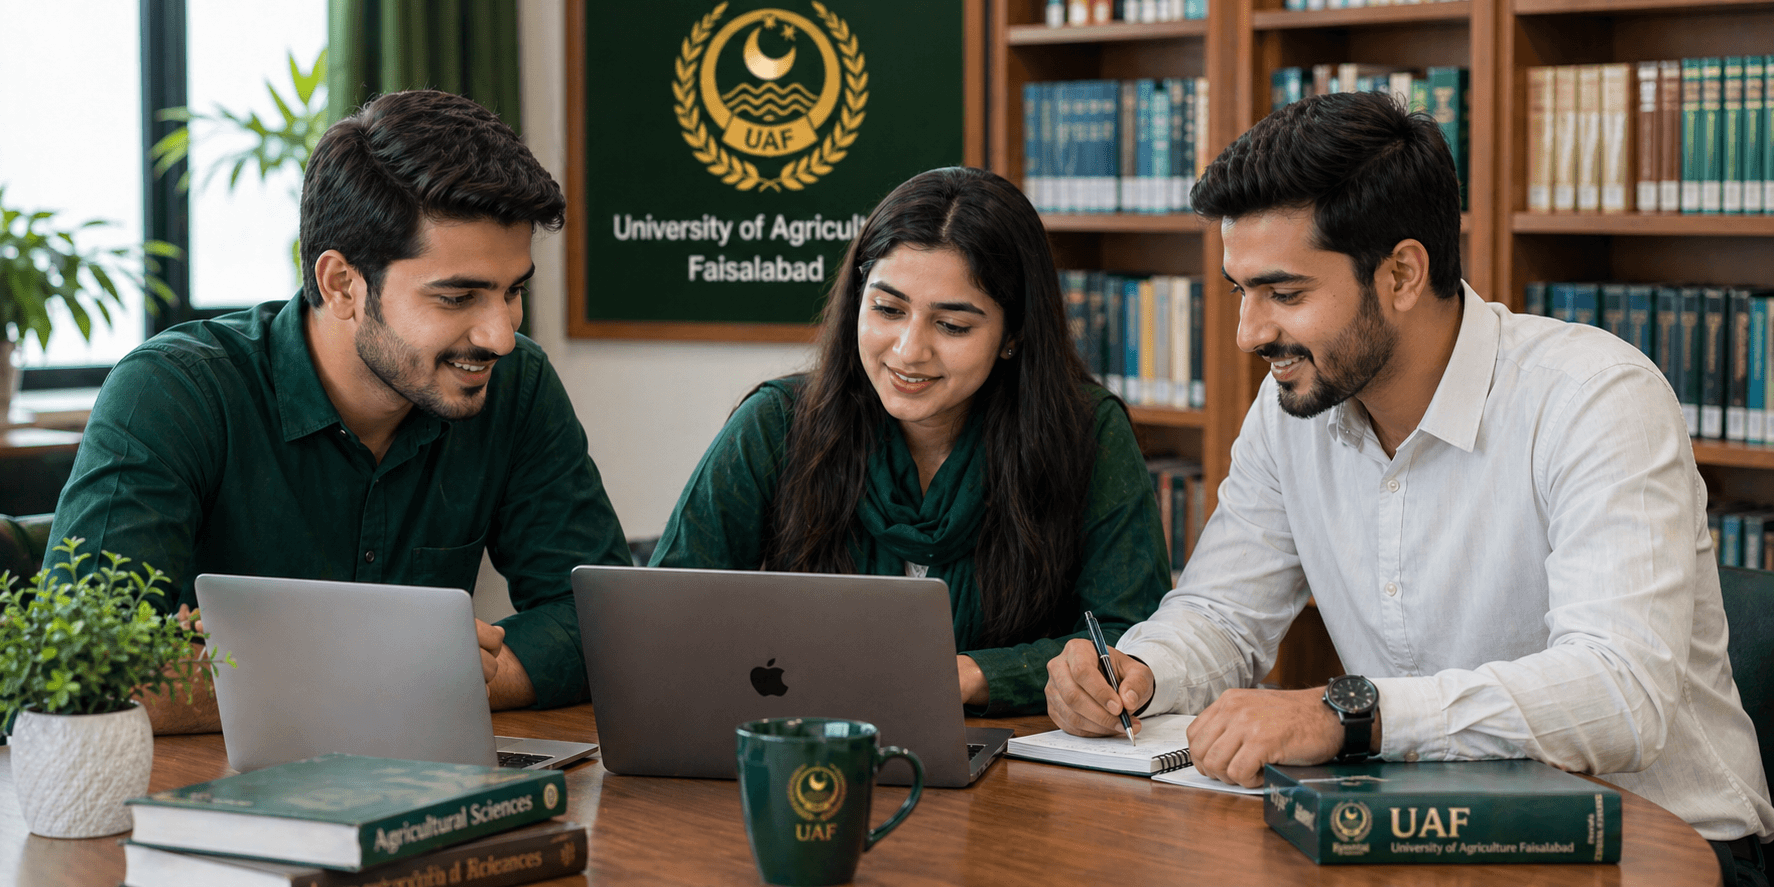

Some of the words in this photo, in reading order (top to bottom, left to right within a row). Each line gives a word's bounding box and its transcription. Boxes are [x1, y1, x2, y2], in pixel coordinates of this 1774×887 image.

[744, 127, 795, 150] UAF
[613, 213, 734, 247] University
[738, 213, 767, 241] of
[688, 254, 824, 282] Faisalabad
[374, 805, 468, 854] Agricultural
[470, 794, 533, 826] Sciences
[795, 823, 838, 841] UAF
[1389, 807, 1471, 838] UAF
[1390, 842, 1443, 856] University
[1445, 842, 1457, 853] of
[1459, 842, 1517, 856] Agriculture
[1519, 842, 1575, 853] Faisalabad
